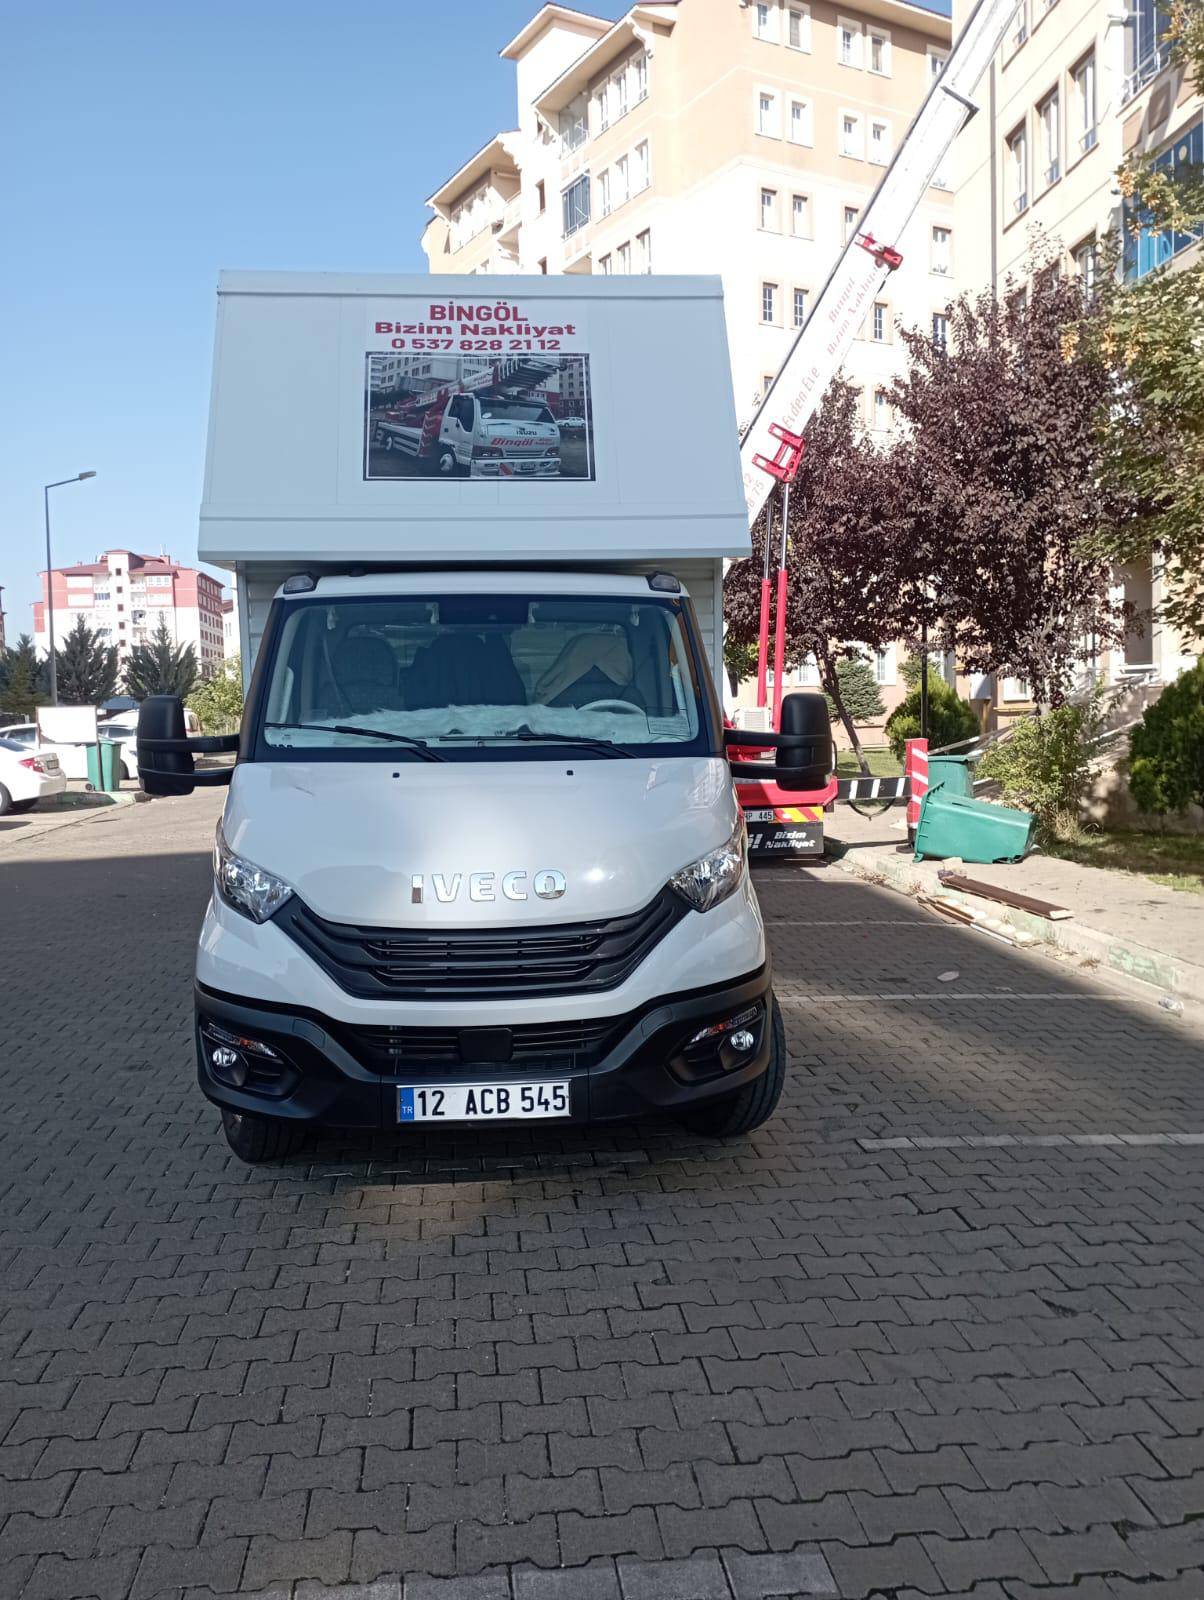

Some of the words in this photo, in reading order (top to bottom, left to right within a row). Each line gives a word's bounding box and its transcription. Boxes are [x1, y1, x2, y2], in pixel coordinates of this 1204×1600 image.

[429, 301, 529, 322] BİNGÖL
[374, 322, 451, 335] Bizim
[460, 323, 576, 338] Nakliyat
[391, 338, 406, 349] 0
[412, 338, 454, 350] 537
[459, 339, 503, 351] 828
[491, 437, 534, 447] Bingöl
[759, 811, 773, 820] 445
[411, 869, 567, 904] IVECO
[417, 1089, 446, 1117] 12
[465, 1087, 511, 1116] ACB
[520, 1084, 567, 1114] 545
[402, 1105, 414, 1115] TR
